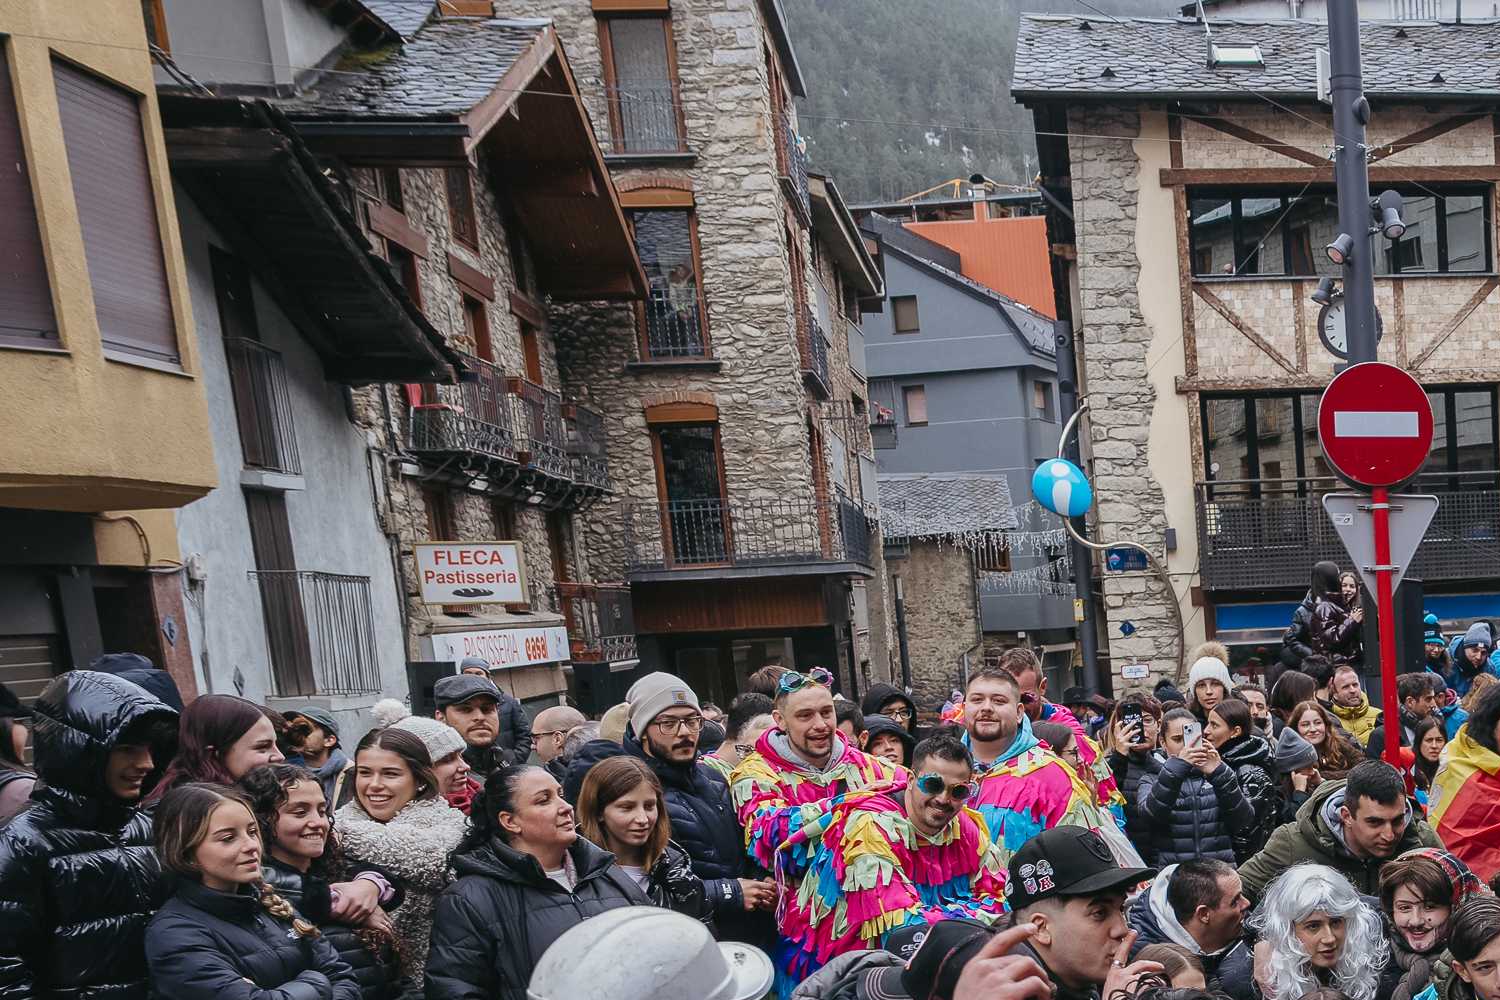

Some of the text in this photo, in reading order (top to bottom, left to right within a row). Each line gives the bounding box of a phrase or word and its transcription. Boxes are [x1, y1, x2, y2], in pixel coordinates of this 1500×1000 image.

[433, 550, 504, 566] FLECA
[424, 569, 518, 585] Pastisseria
[464, 634, 521, 667] PASTISSERIA
